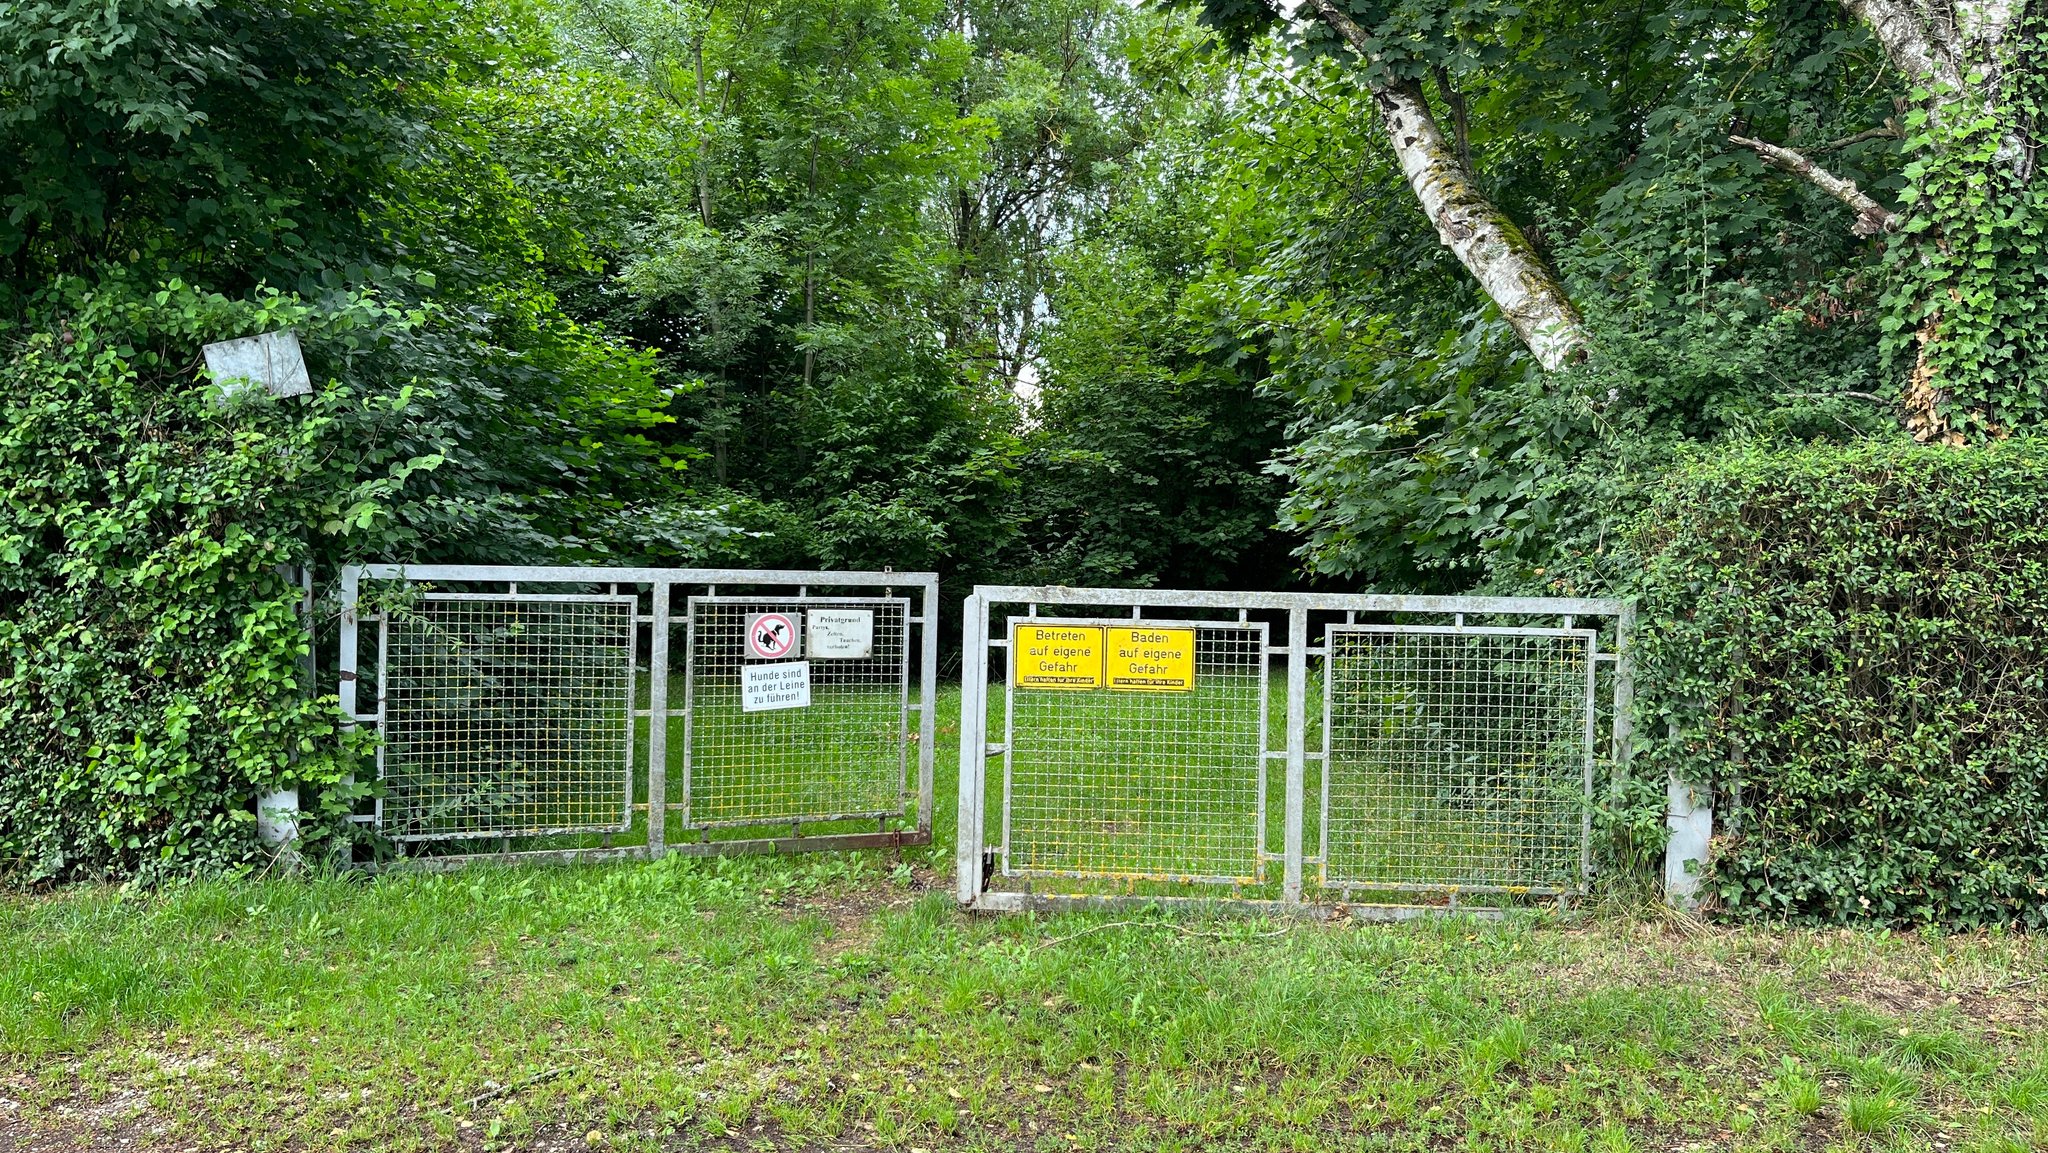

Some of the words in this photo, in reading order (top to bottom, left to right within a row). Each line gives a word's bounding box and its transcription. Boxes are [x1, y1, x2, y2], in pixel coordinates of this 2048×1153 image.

[1036, 630, 1086, 641] Betreten
[1131, 632, 1169, 643] Baden
[1029, 646, 1049, 656] auf
[1053, 647, 1091, 659] eigene
[1119, 648, 1139, 658] auf
[1143, 648, 1182, 661] eigene
[1039, 661, 1078, 672] Gefahr
[1129, 663, 1168, 674] Gefahr
[750, 671, 779, 681] Hunde
[783, 669, 802, 678] sind
[748, 685, 759, 693] an
[762, 682, 777, 692] der
[780, 680, 805, 690] Leine
[754, 696, 764, 704] zu
[767, 692, 800, 703] führen!
